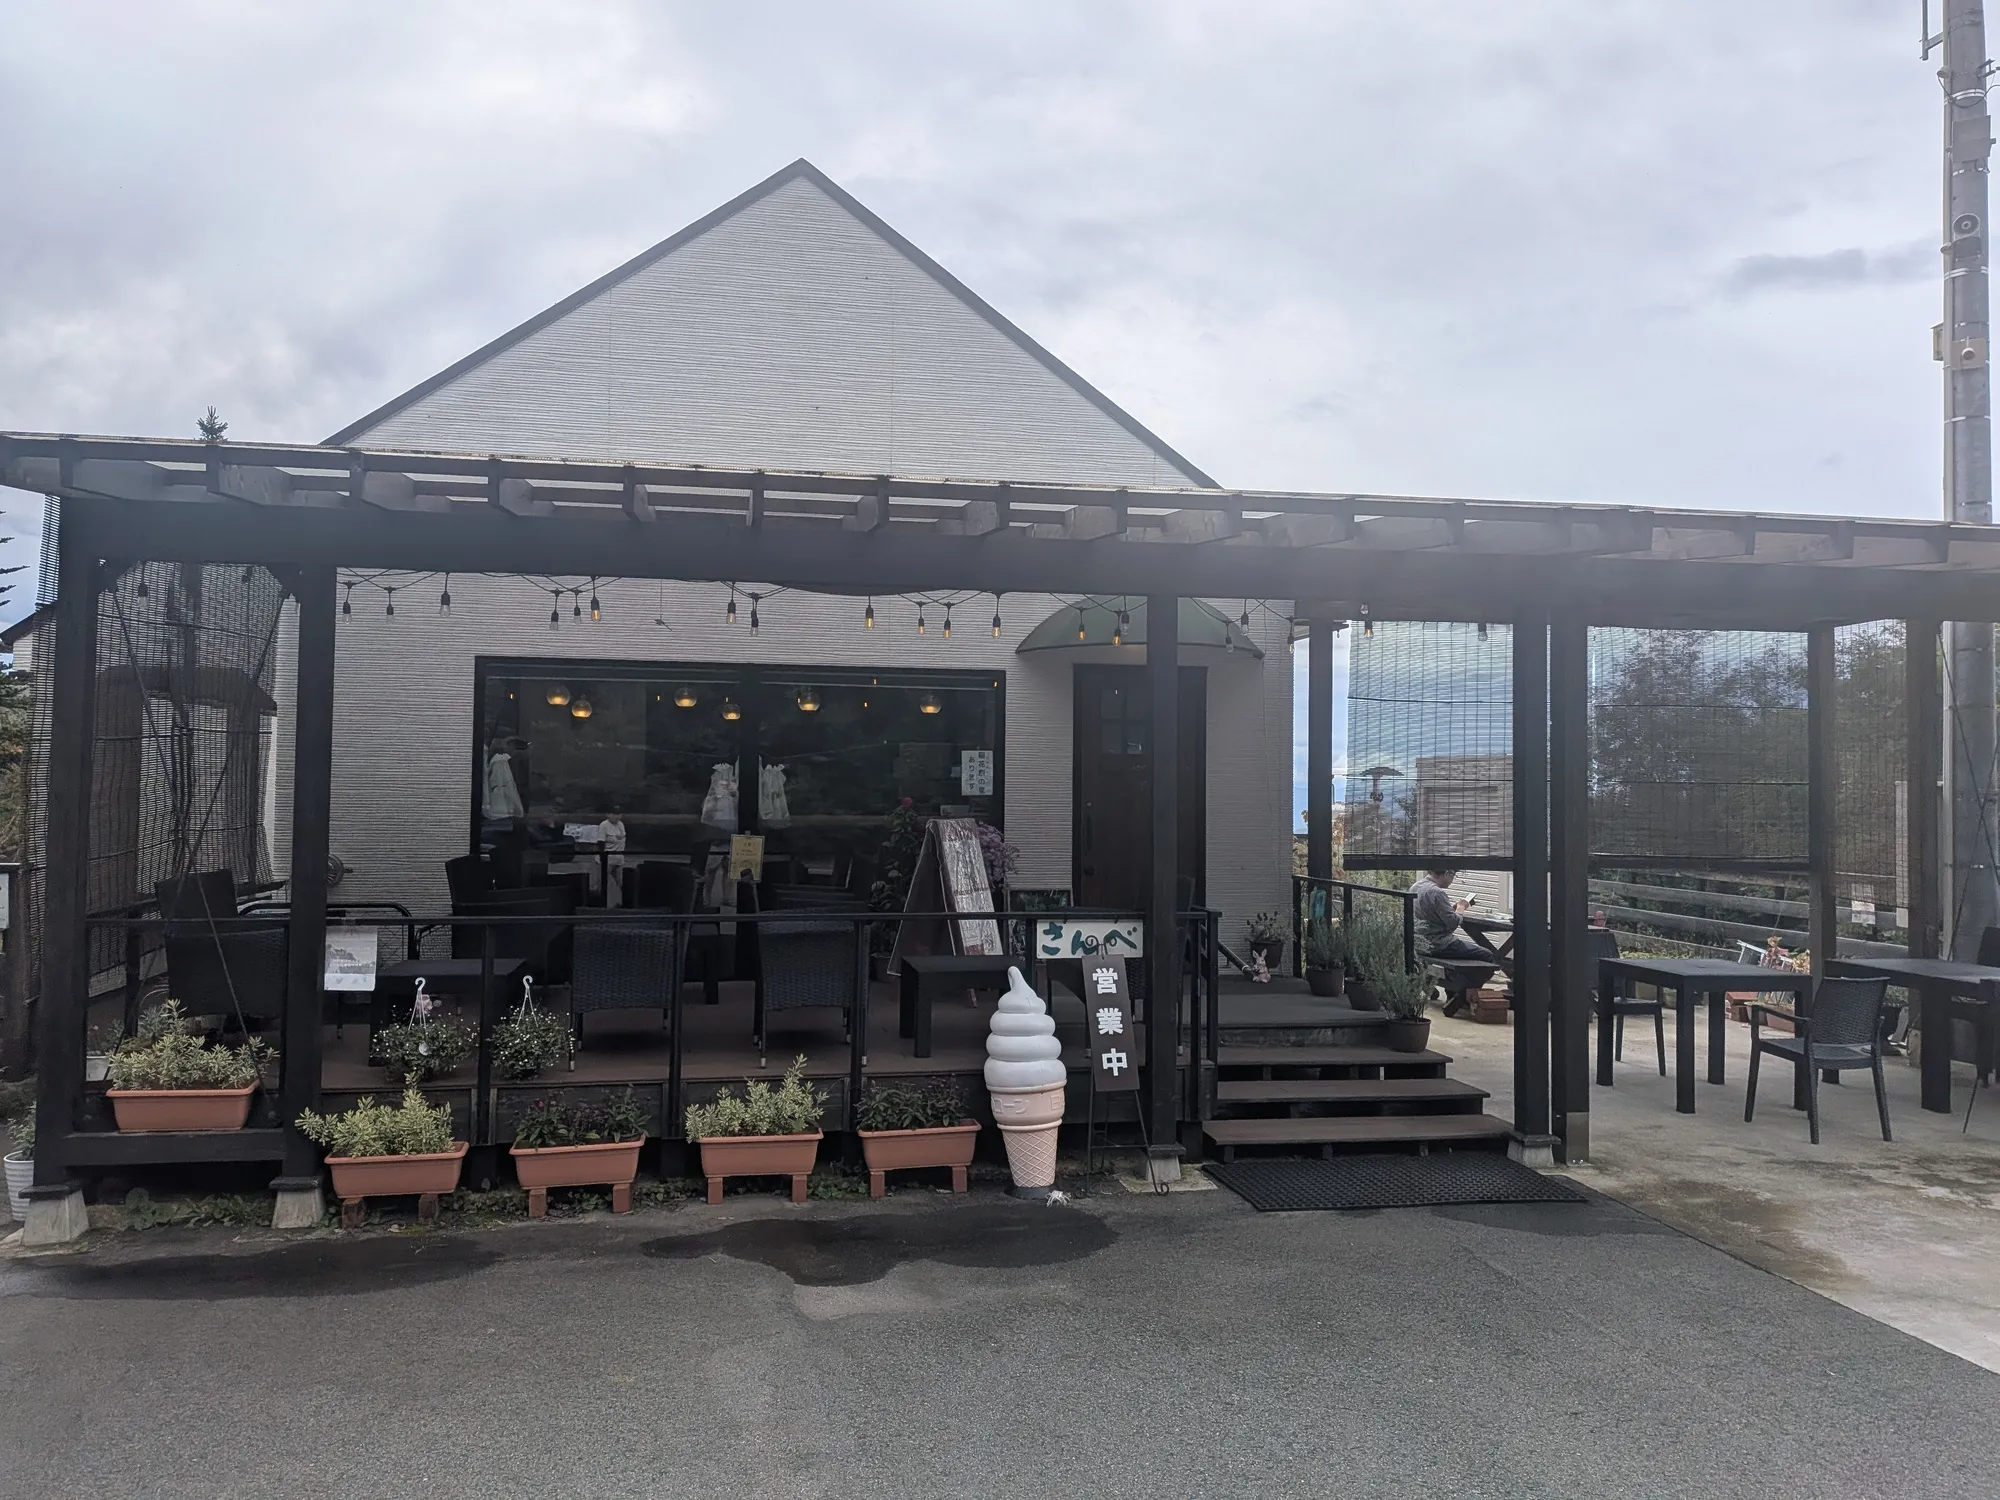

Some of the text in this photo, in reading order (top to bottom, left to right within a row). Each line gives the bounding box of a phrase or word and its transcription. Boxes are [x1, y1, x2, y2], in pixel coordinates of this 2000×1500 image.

[1042, 921, 1138, 956] さんべ
[1092, 967, 1128, 1077] 営業中
